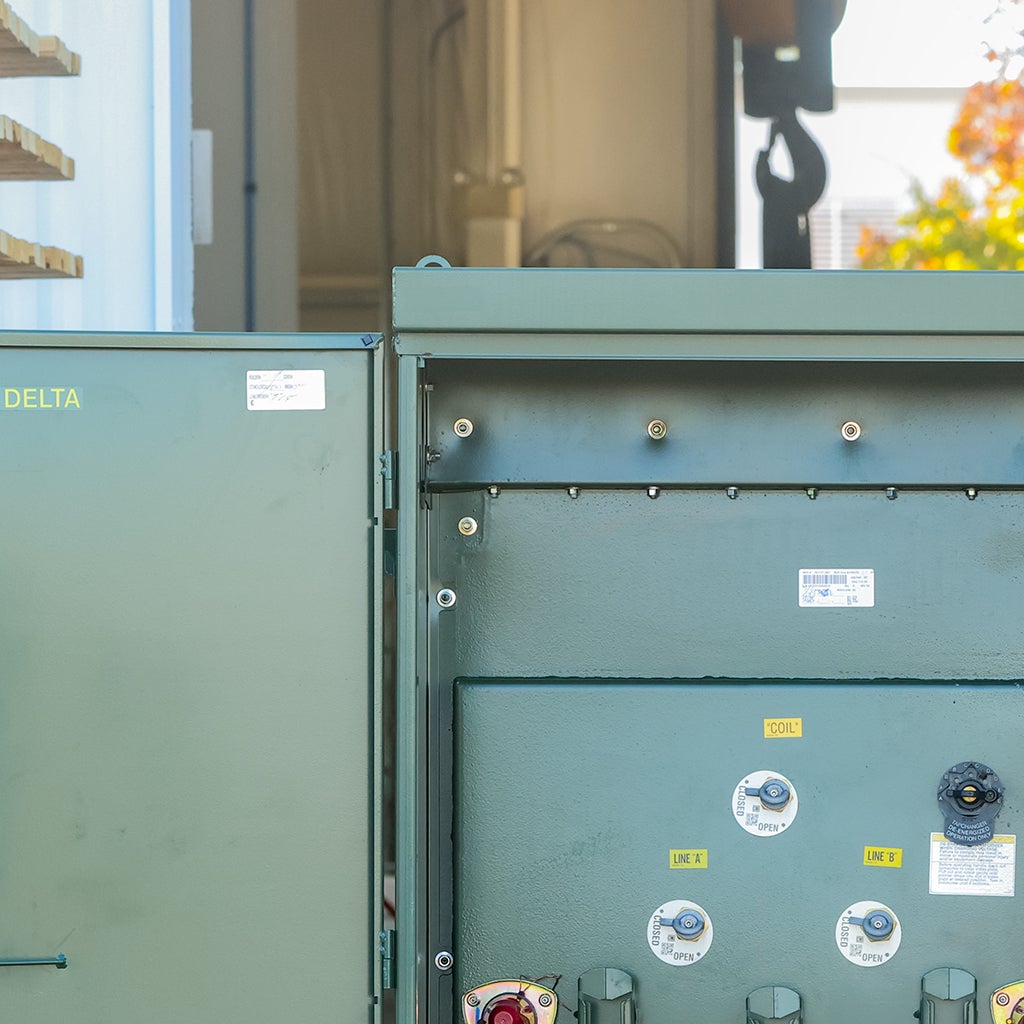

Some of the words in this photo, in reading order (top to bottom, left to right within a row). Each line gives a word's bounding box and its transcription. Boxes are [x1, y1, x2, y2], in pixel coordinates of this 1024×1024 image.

[4, 388, 81, 409] DELTA
[736, 785, 746, 817] CLOSED
[757, 822, 780, 832] OPEN
[945, 829, 977, 842] OPERATION
[977, 831, 992, 842] ONLY
[673, 853, 691, 864] LINE
[867, 850, 885, 862] LINE
[651, 914, 661, 947] CLOSED
[840, 916, 850, 948] CLOSED
[673, 952, 694, 962] OPEN
[862, 953, 883, 963] OPEN
